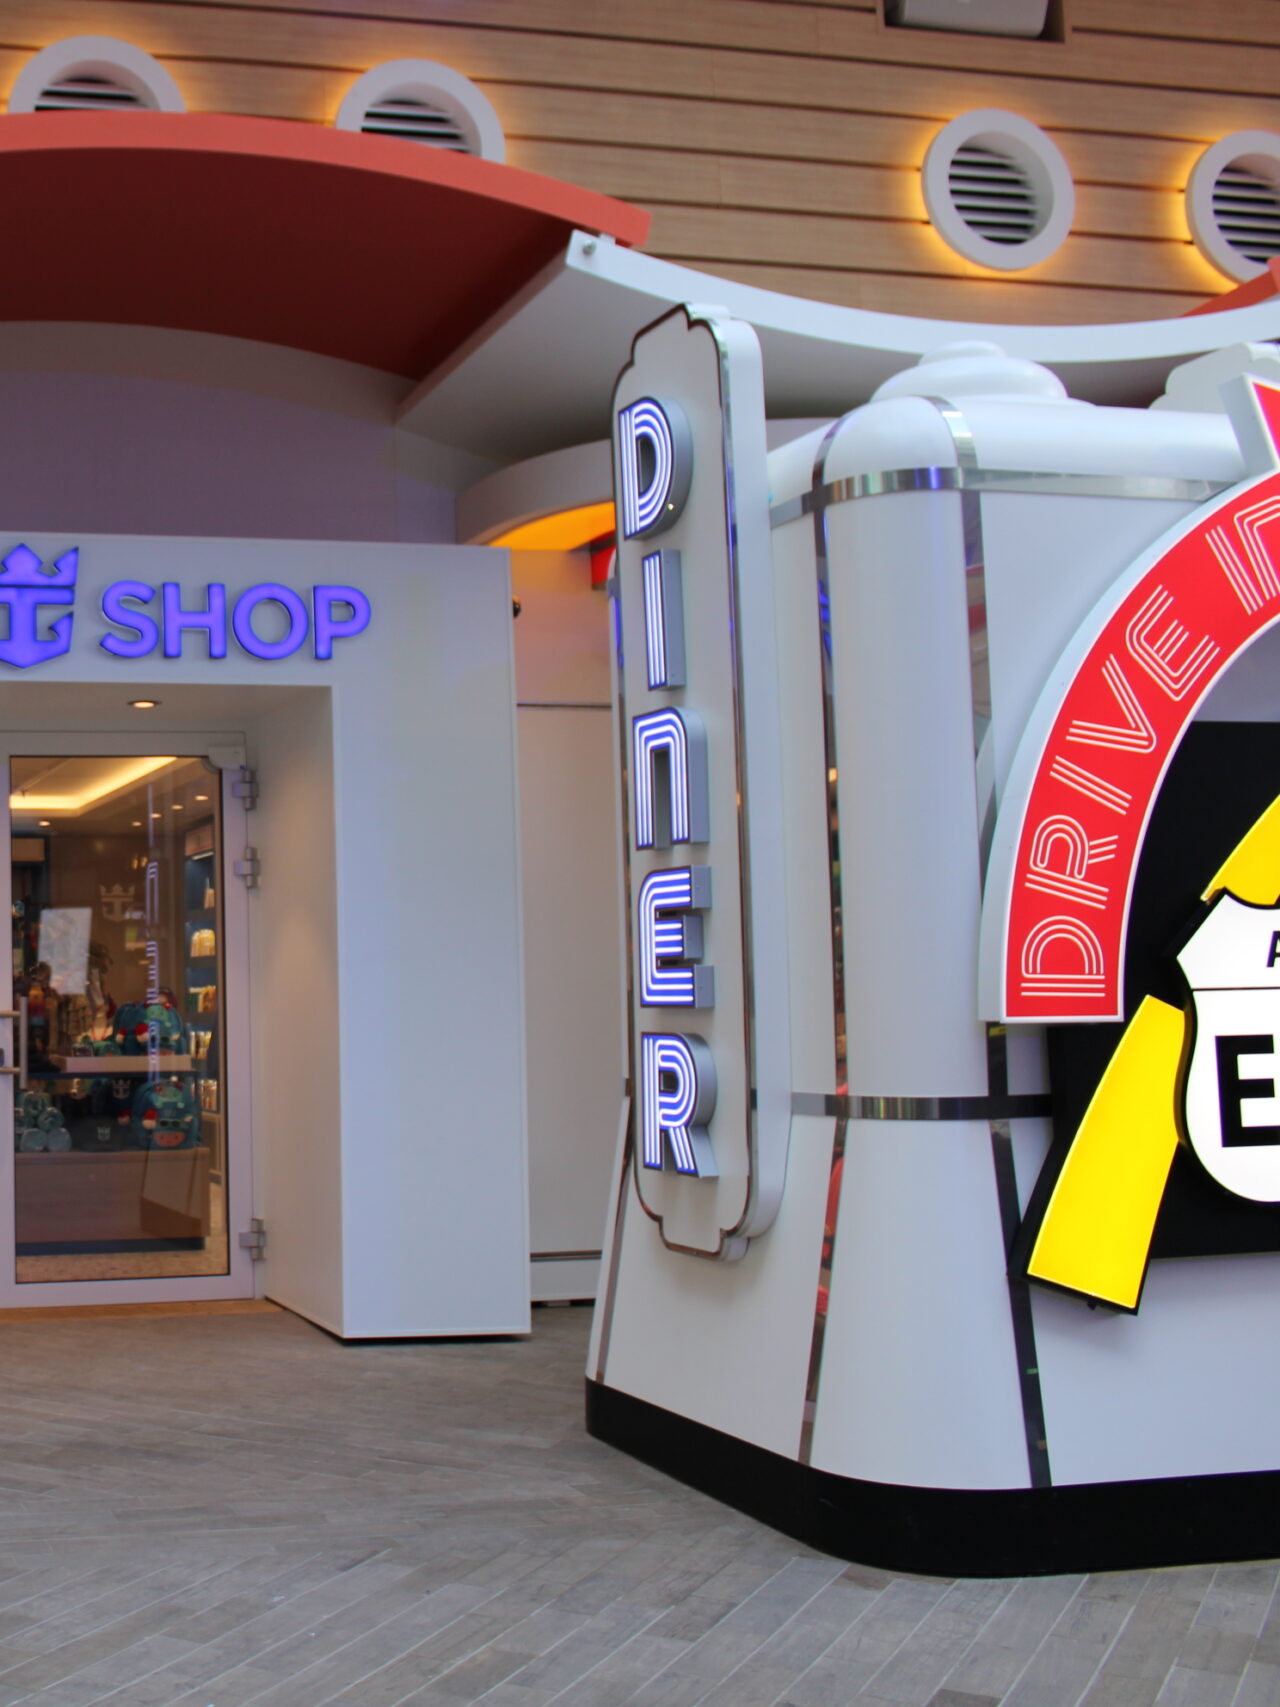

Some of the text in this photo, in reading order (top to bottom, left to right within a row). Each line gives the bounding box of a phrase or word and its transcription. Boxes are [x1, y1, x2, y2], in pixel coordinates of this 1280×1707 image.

[100, 579, 372, 660] SHOP
[617, 397, 706, 1179] DINER
[1021, 584, 1220, 998] DRIVE
